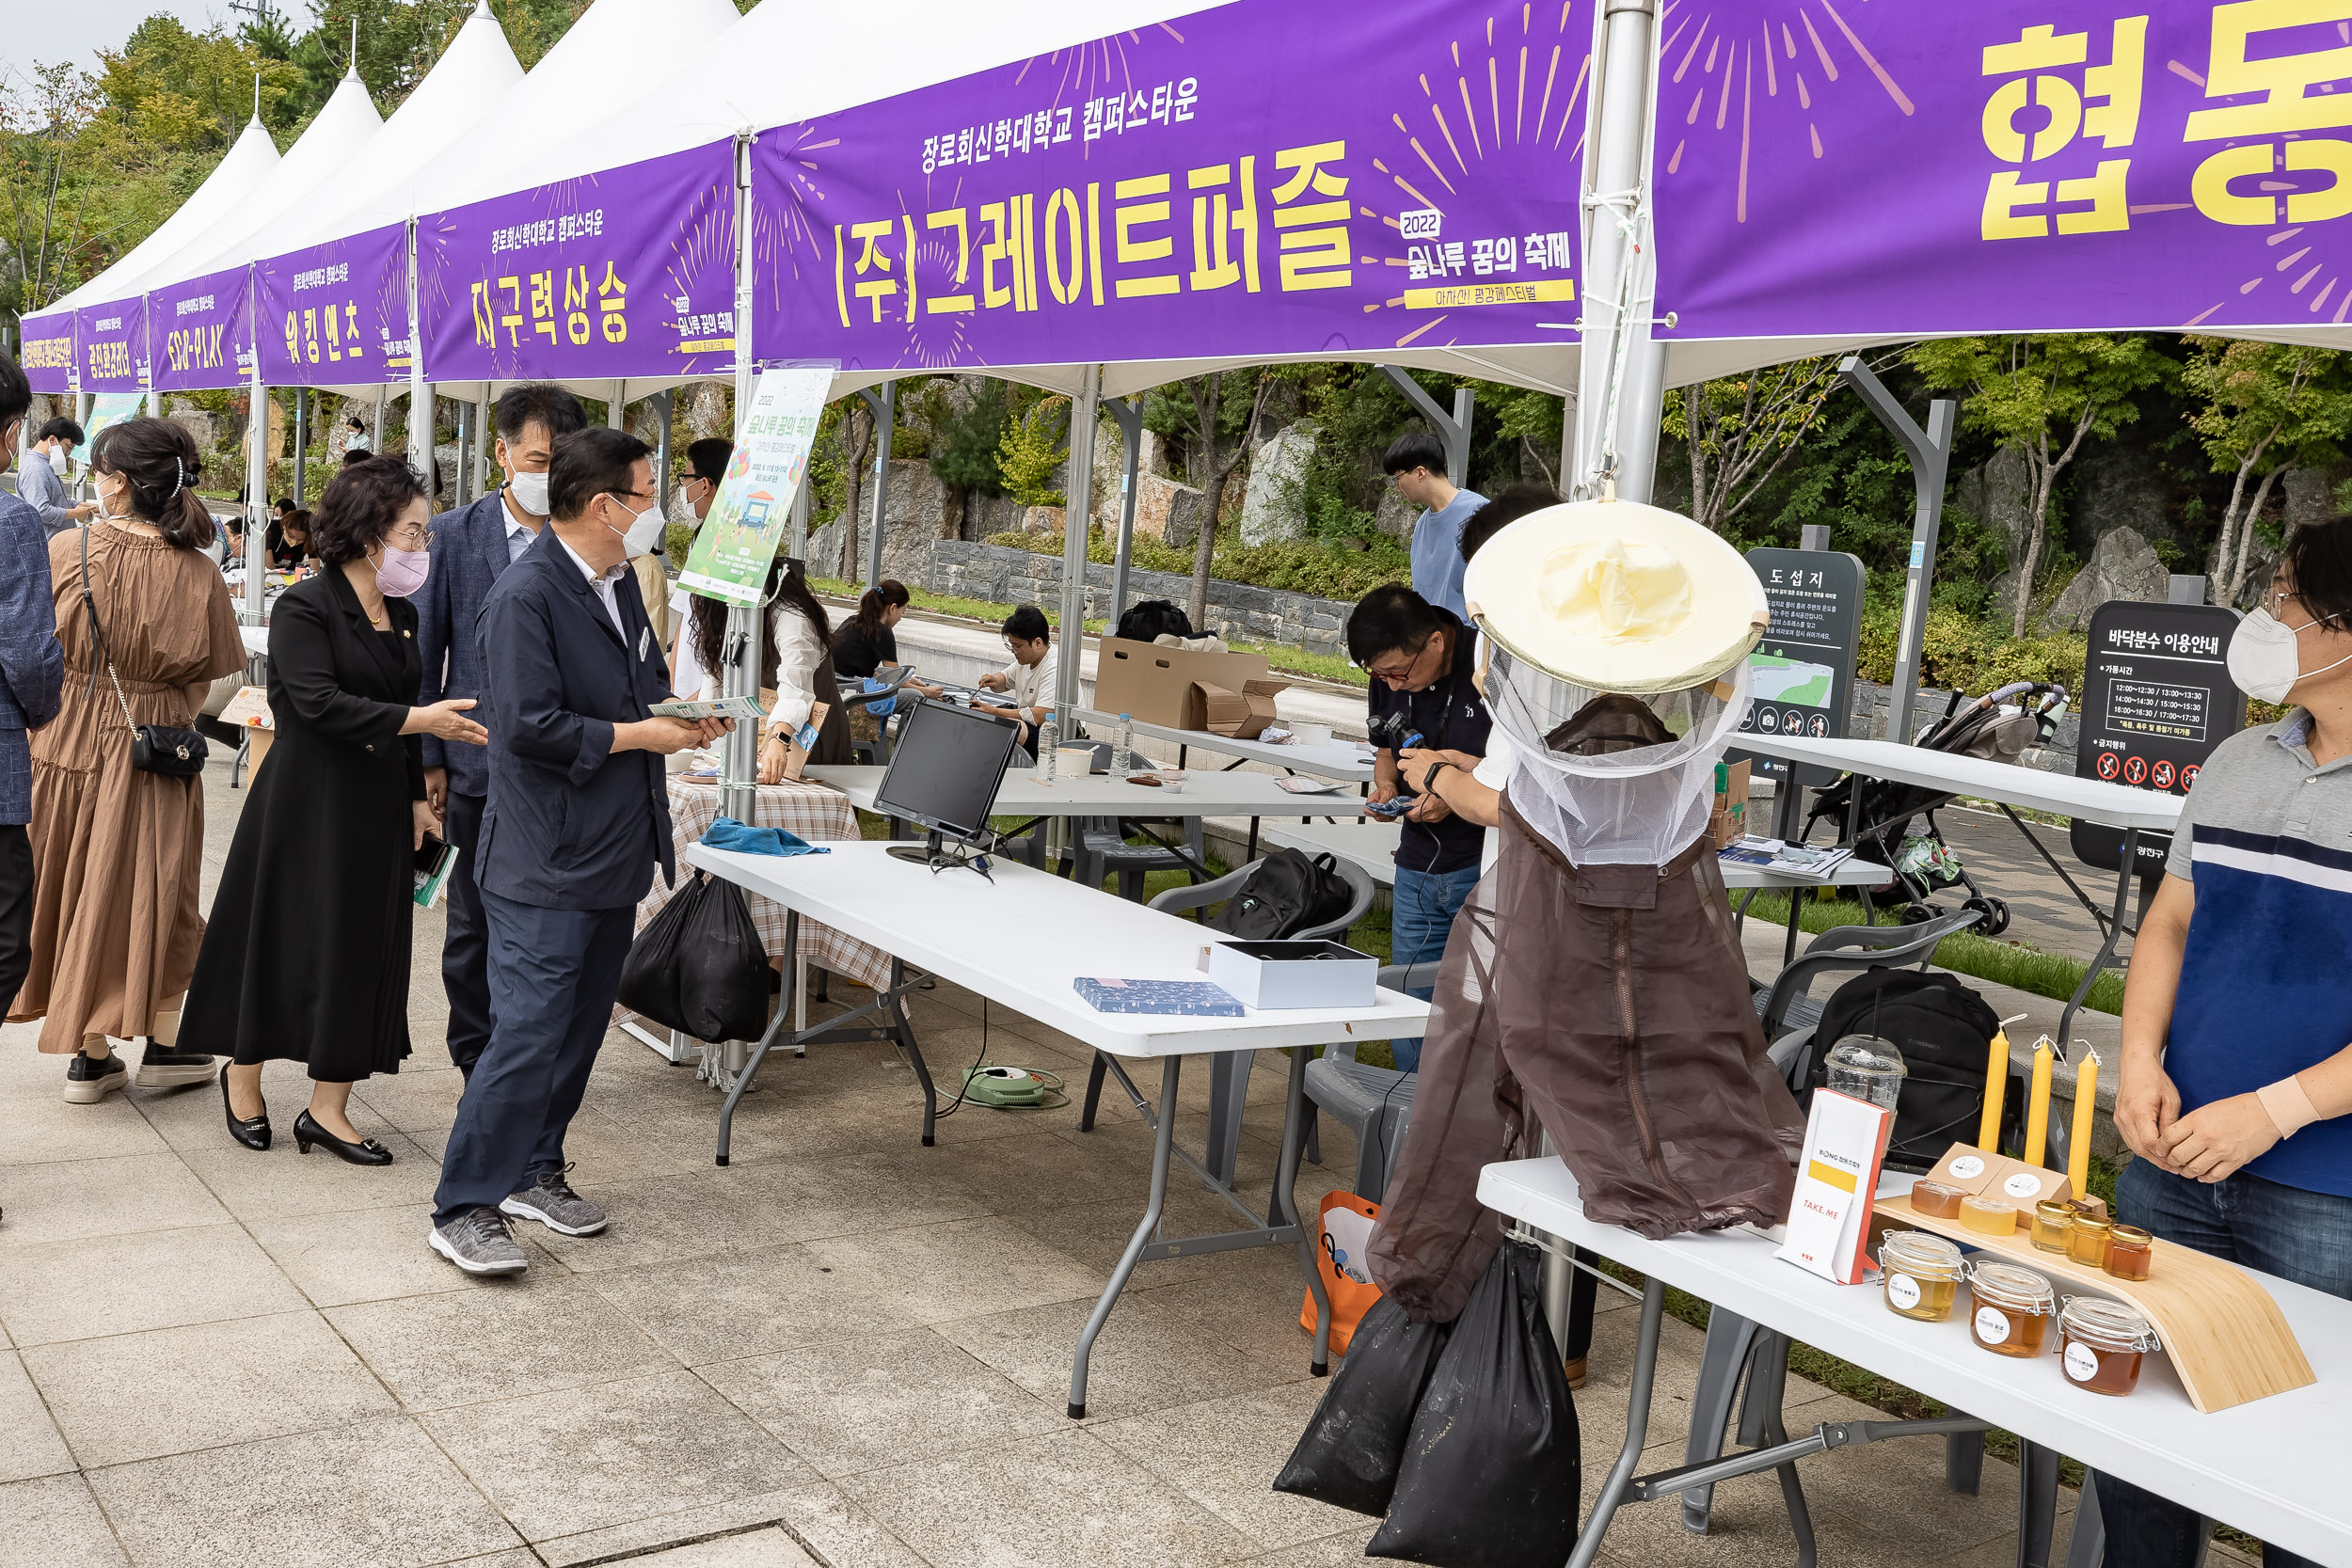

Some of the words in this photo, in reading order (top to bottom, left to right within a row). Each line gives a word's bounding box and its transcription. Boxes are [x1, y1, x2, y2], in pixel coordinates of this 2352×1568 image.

[922, 107, 1073, 174] 장로회신학대학교
[1082, 76, 1199, 138] 캠퍼스타운
[1981, 0, 2352, 241] 협동
[491, 218, 555, 255] 장로회신학대학교
[558, 208, 603, 243] 캠퍼스타운
[834, 139, 1353, 328] (주)그레이트퍼즐
[1404, 214, 1438, 234] 2022
[1407, 241, 1467, 280] 숲나루
[1470, 236, 1518, 276] 꿈의
[1523, 231, 1571, 271] 축제
[470, 260, 628, 349] 지구력상승
[1436, 291, 1471, 306] 아차산!
[1474, 285, 1537, 304] 평강페스티벌
[167, 324, 224, 372] ECO-PLAY
[758, 395, 774, 406] 2022
[747, 414, 778, 436] 숲나루
[776, 416, 798, 436] 꿈의
[2108, 629, 2161, 650] 바닥분수
[2164, 633, 2219, 655] 이용안내
[2106, 664, 2134, 675] 가동시간
[2116, 685, 2155, 695] 12:00~12:30
[2161, 689, 2202, 700] 13:00~13:30
[2115, 695, 2154, 705] 14:00~14:30
[2160, 700, 2201, 711] 15:00~15:30
[2114, 706, 2153, 717] 16:00~16:30
[2159, 711, 2201, 722] 17:00~17:30
[2099, 738, 2126, 751] 금지행위
[2137, 846, 2165, 859] 광진구
[1820, 1148, 1838, 1161] BONG
[1804, 1199, 1825, 1214] TAKE.
[1825, 1209, 1838, 1219] ME
